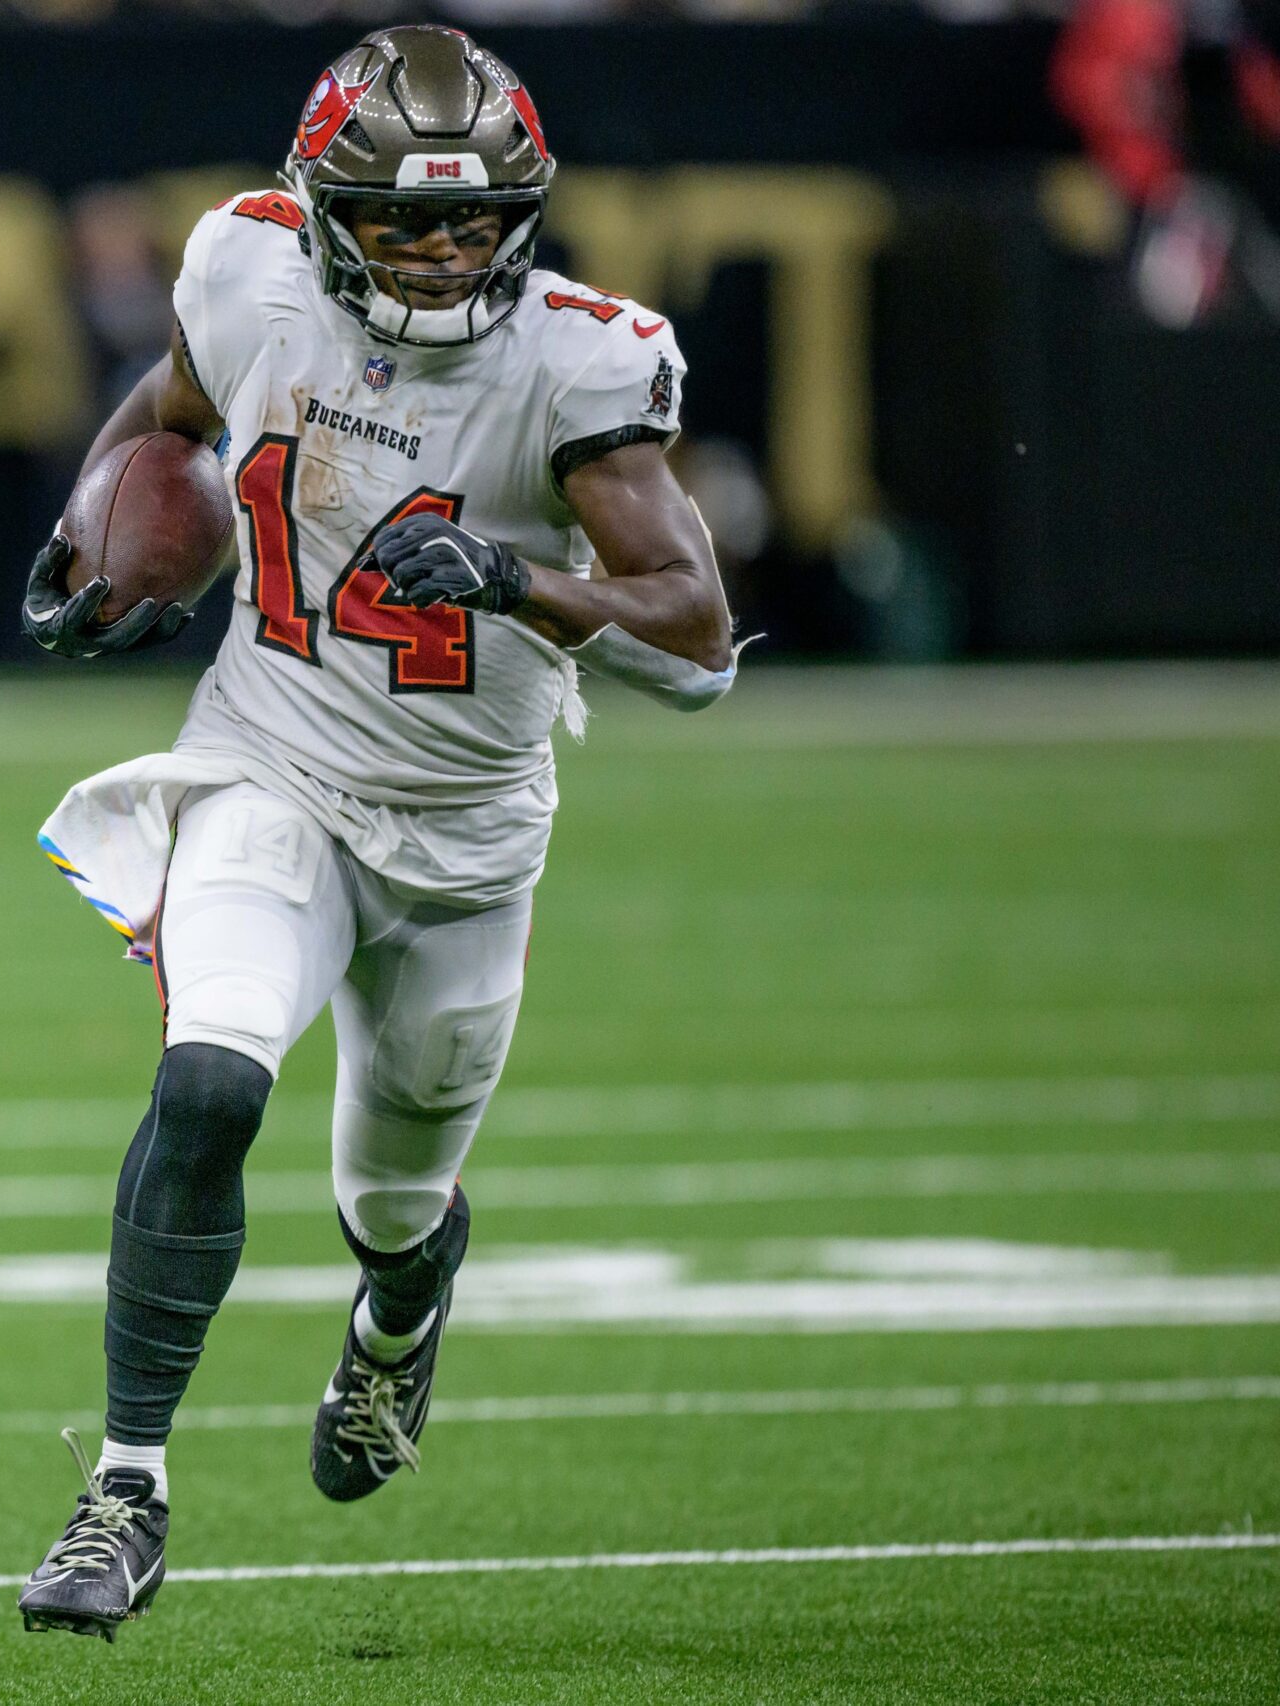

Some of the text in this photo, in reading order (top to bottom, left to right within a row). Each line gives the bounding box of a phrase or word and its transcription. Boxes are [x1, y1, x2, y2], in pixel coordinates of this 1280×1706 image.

[426, 161, 461, 178] BUCS
[367, 369, 386, 387] NFL
[304, 397, 421, 460] BUCCANEERS
[235, 432, 475, 694] 14
[220, 808, 303, 877] 14
